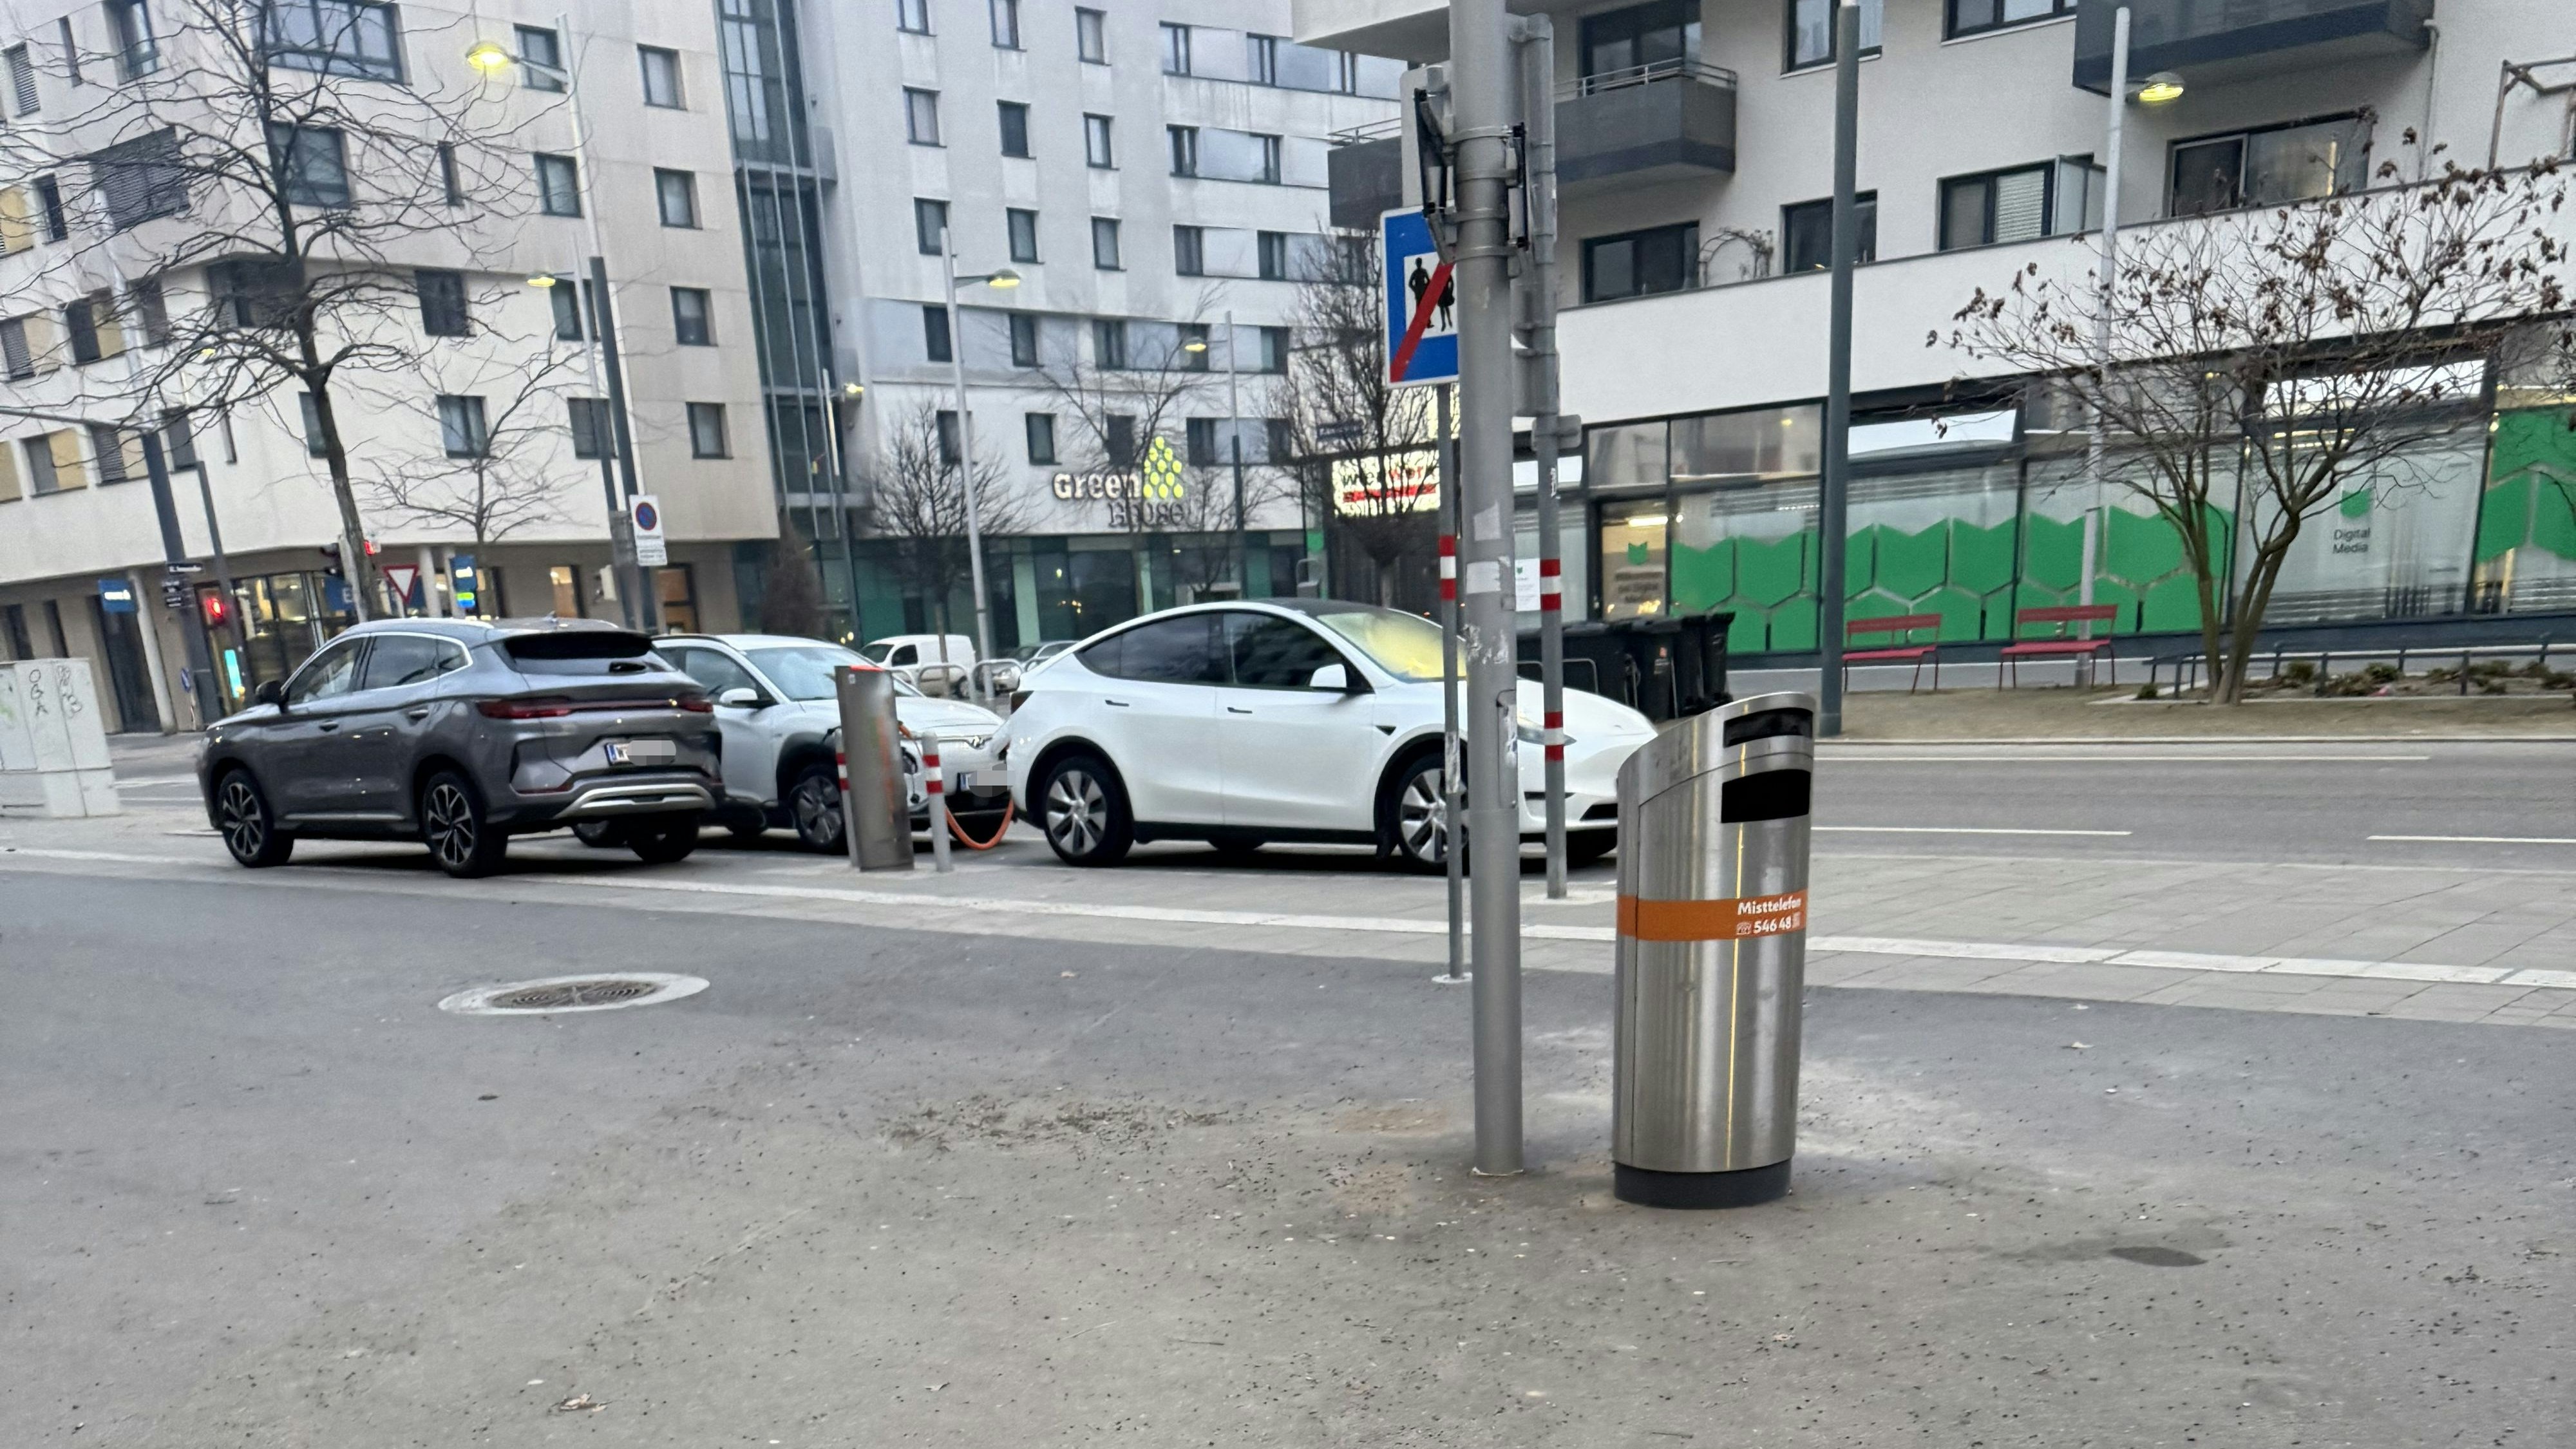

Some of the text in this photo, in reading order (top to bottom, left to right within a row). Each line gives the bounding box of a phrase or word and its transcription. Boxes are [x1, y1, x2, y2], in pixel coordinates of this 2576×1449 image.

[1053, 473, 1142, 499] Green
[2333, 527, 2371, 542] Digital
[2333, 543, 2369, 554] Media
[1738, 895, 1801, 915] Misttelefon
[1753, 916, 1792, 934] 546 48
